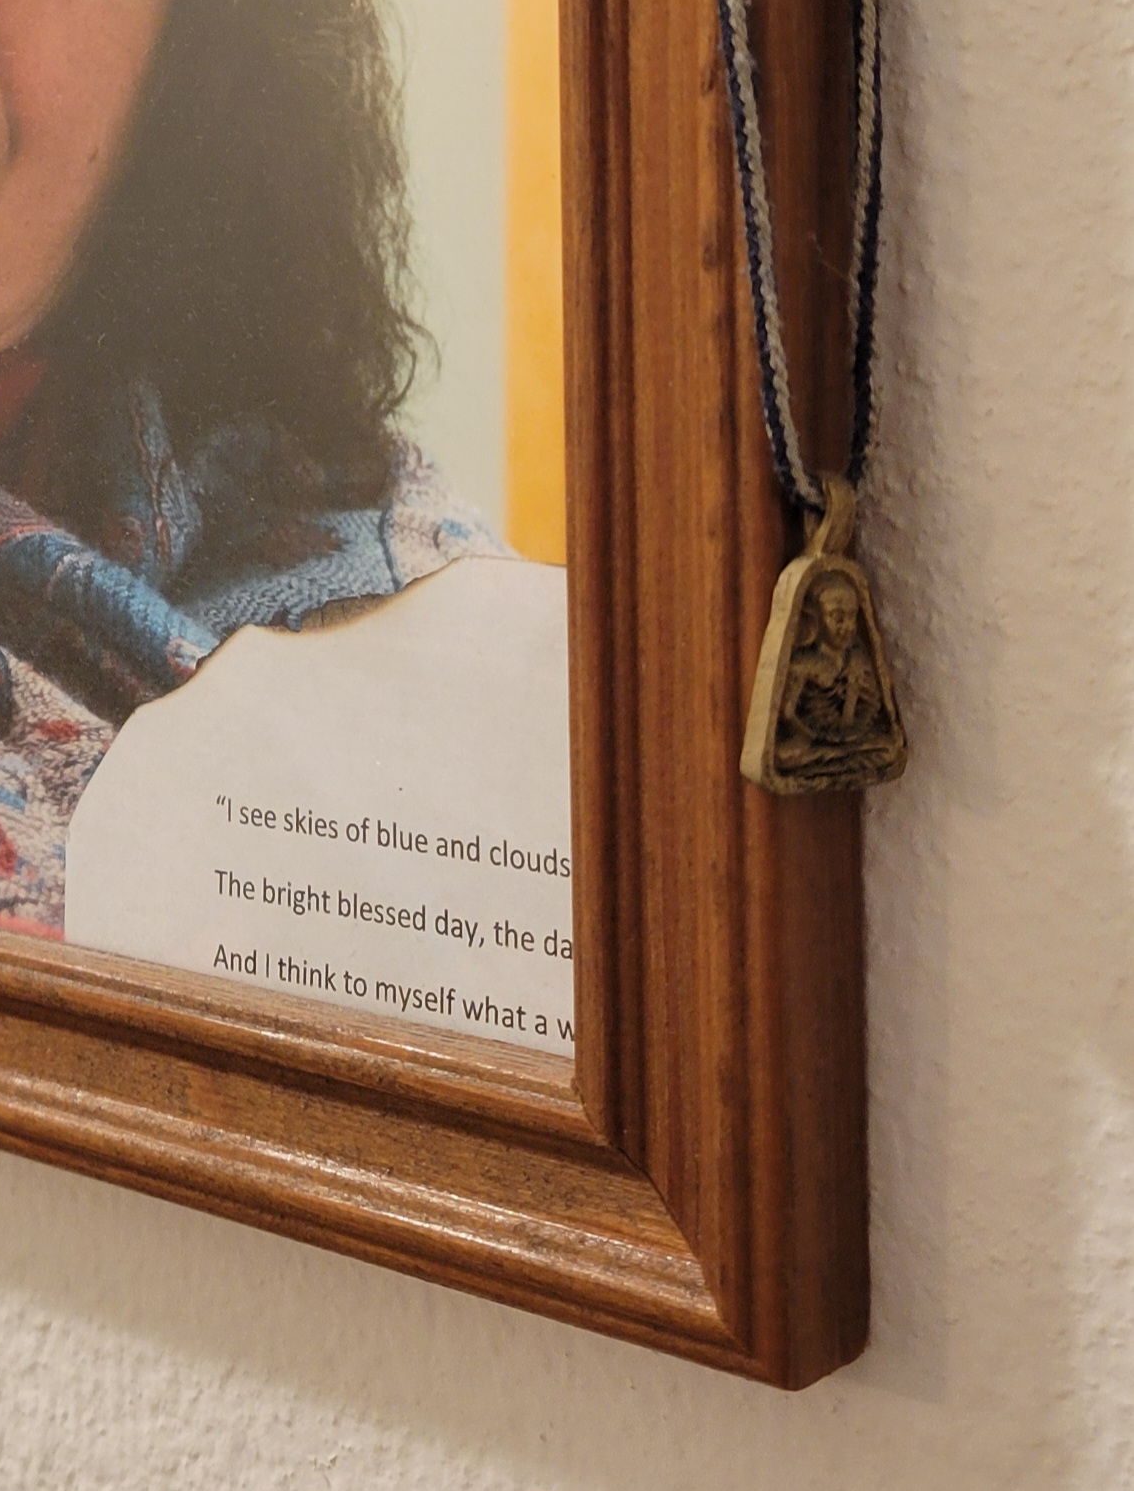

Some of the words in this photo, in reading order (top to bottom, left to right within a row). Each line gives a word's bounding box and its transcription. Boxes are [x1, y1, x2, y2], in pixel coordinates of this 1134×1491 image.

[240, 806, 276, 829] see
[284, 807, 338, 839] skies
[346, 817, 370, 844] of
[377, 820, 428, 853] blue
[436, 835, 480, 862] and
[490, 840, 570, 877] clouds
[214, 870, 255, 900] The
[263, 877, 330, 915] bright
[338, 890, 425, 931] blessed
[435, 909, 484, 948] day,
[493, 920, 534, 952] the
[212, 944, 257, 977] And
[276, 956, 336, 993] think
[343, 971, 367, 997] to
[376, 981, 456, 1014] myself
[462, 996, 526, 1031] what
[535, 1015, 547, 1036] a
